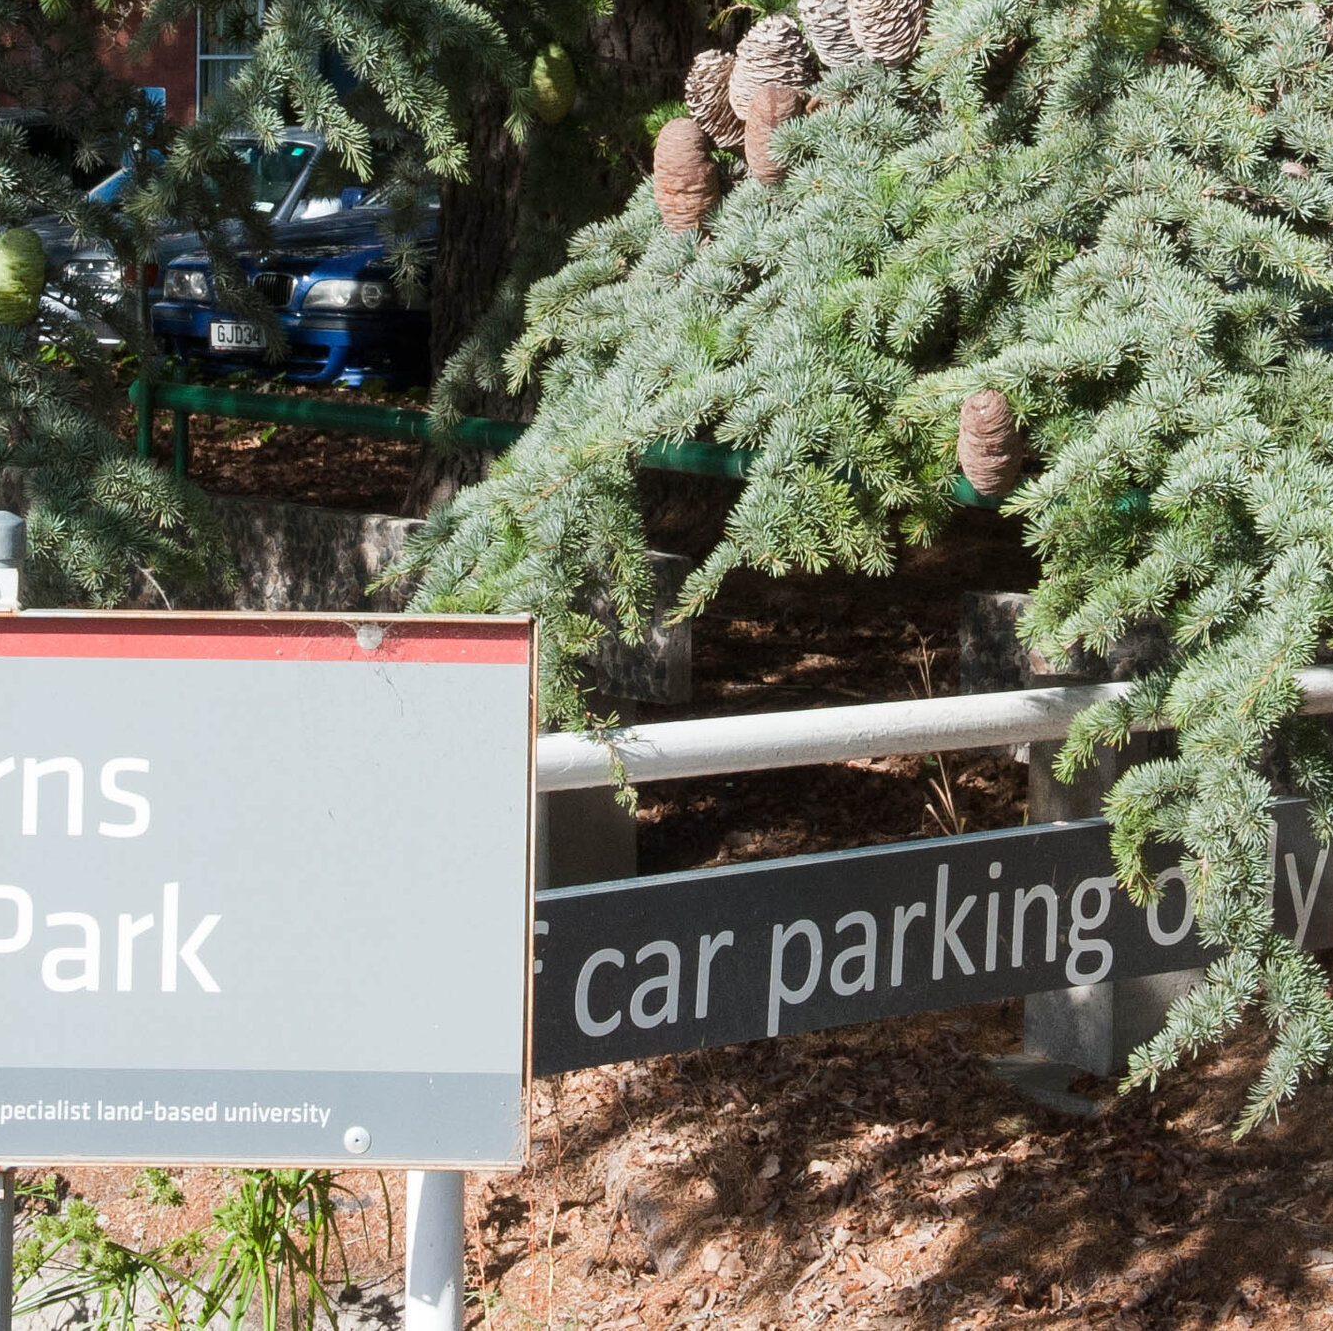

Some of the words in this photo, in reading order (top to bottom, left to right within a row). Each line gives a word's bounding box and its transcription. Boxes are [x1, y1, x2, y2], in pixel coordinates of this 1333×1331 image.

[574, 930, 734, 1038] car
[766, 861, 1117, 1038] parking
[1146, 820, 1330, 950] oly
[96, 1100, 218, 1123] land-based
[223, 1101, 332, 1129] university
